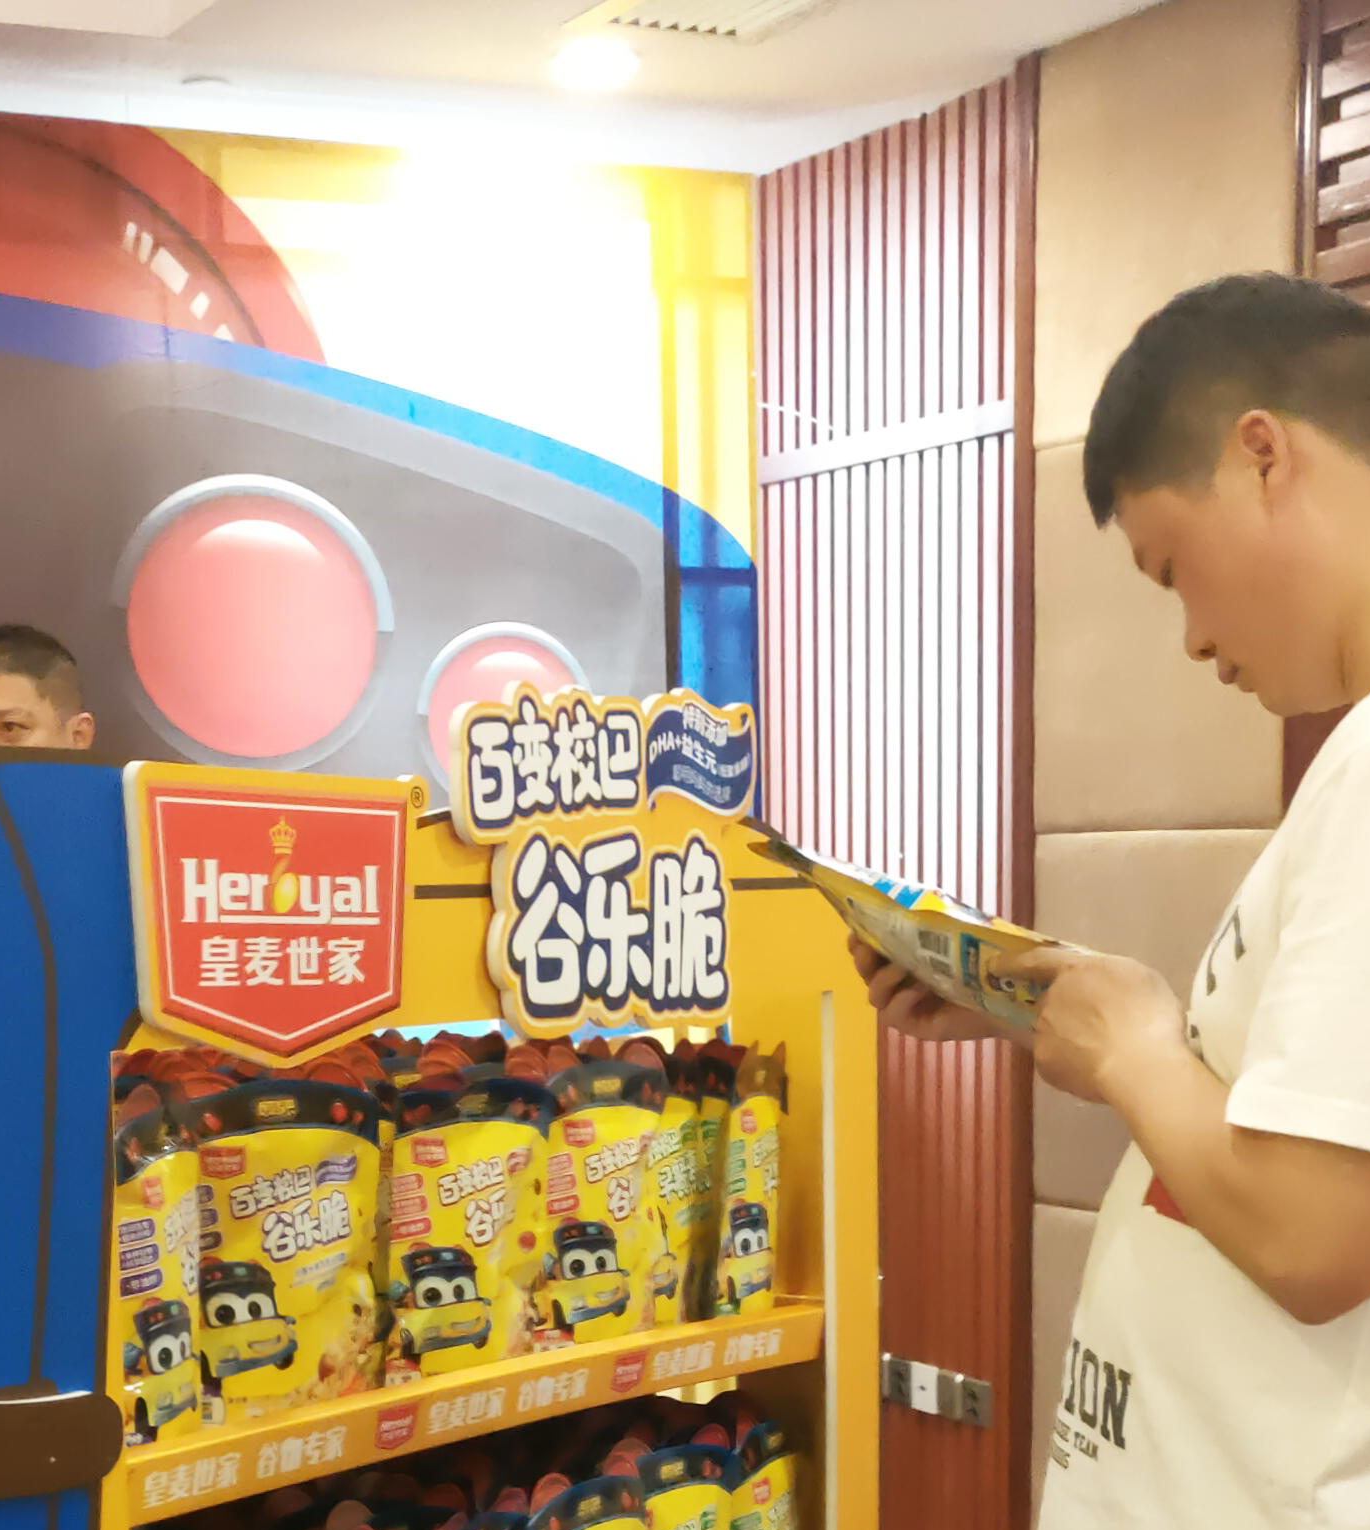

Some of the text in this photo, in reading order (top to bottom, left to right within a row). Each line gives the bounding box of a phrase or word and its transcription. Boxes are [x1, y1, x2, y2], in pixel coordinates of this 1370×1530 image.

[471, 702, 641, 808] 百变校巴
[181, 858, 381, 925] Heroyal
[512, 833, 725, 1008] 谷乐脆
[199, 935, 367, 988] 皇麦世家
[261, 1189, 351, 1263] 谷乐脆
[141, 1450, 242, 1509] 皇麦世家
